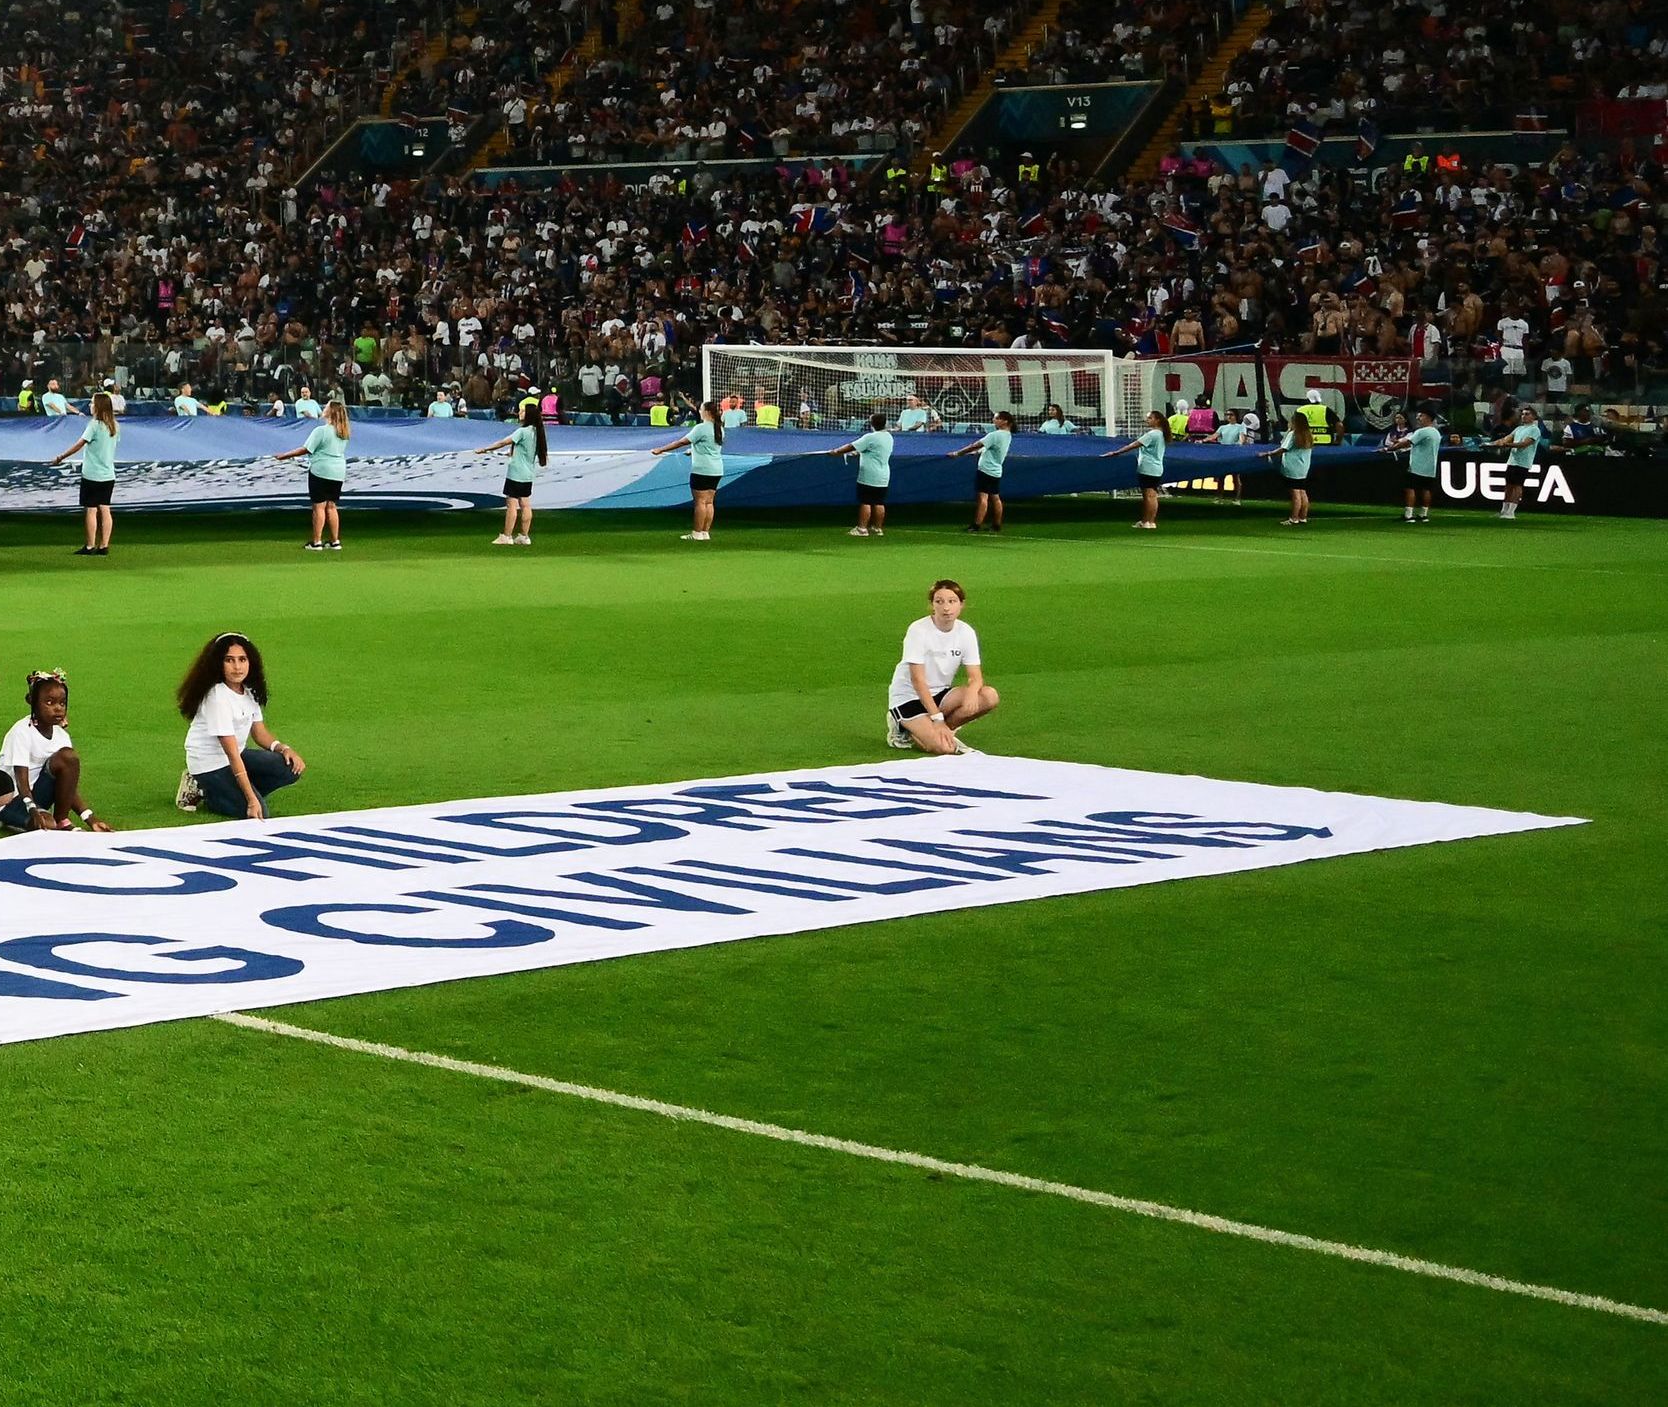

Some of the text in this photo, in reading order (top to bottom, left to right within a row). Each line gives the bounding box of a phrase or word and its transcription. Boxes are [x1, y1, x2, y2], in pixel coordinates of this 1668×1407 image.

[1066, 96, 1091, 108] V13
[982, 359, 1348, 425] ULTRAS
[260, 810, 1335, 950] CIVILIANS
